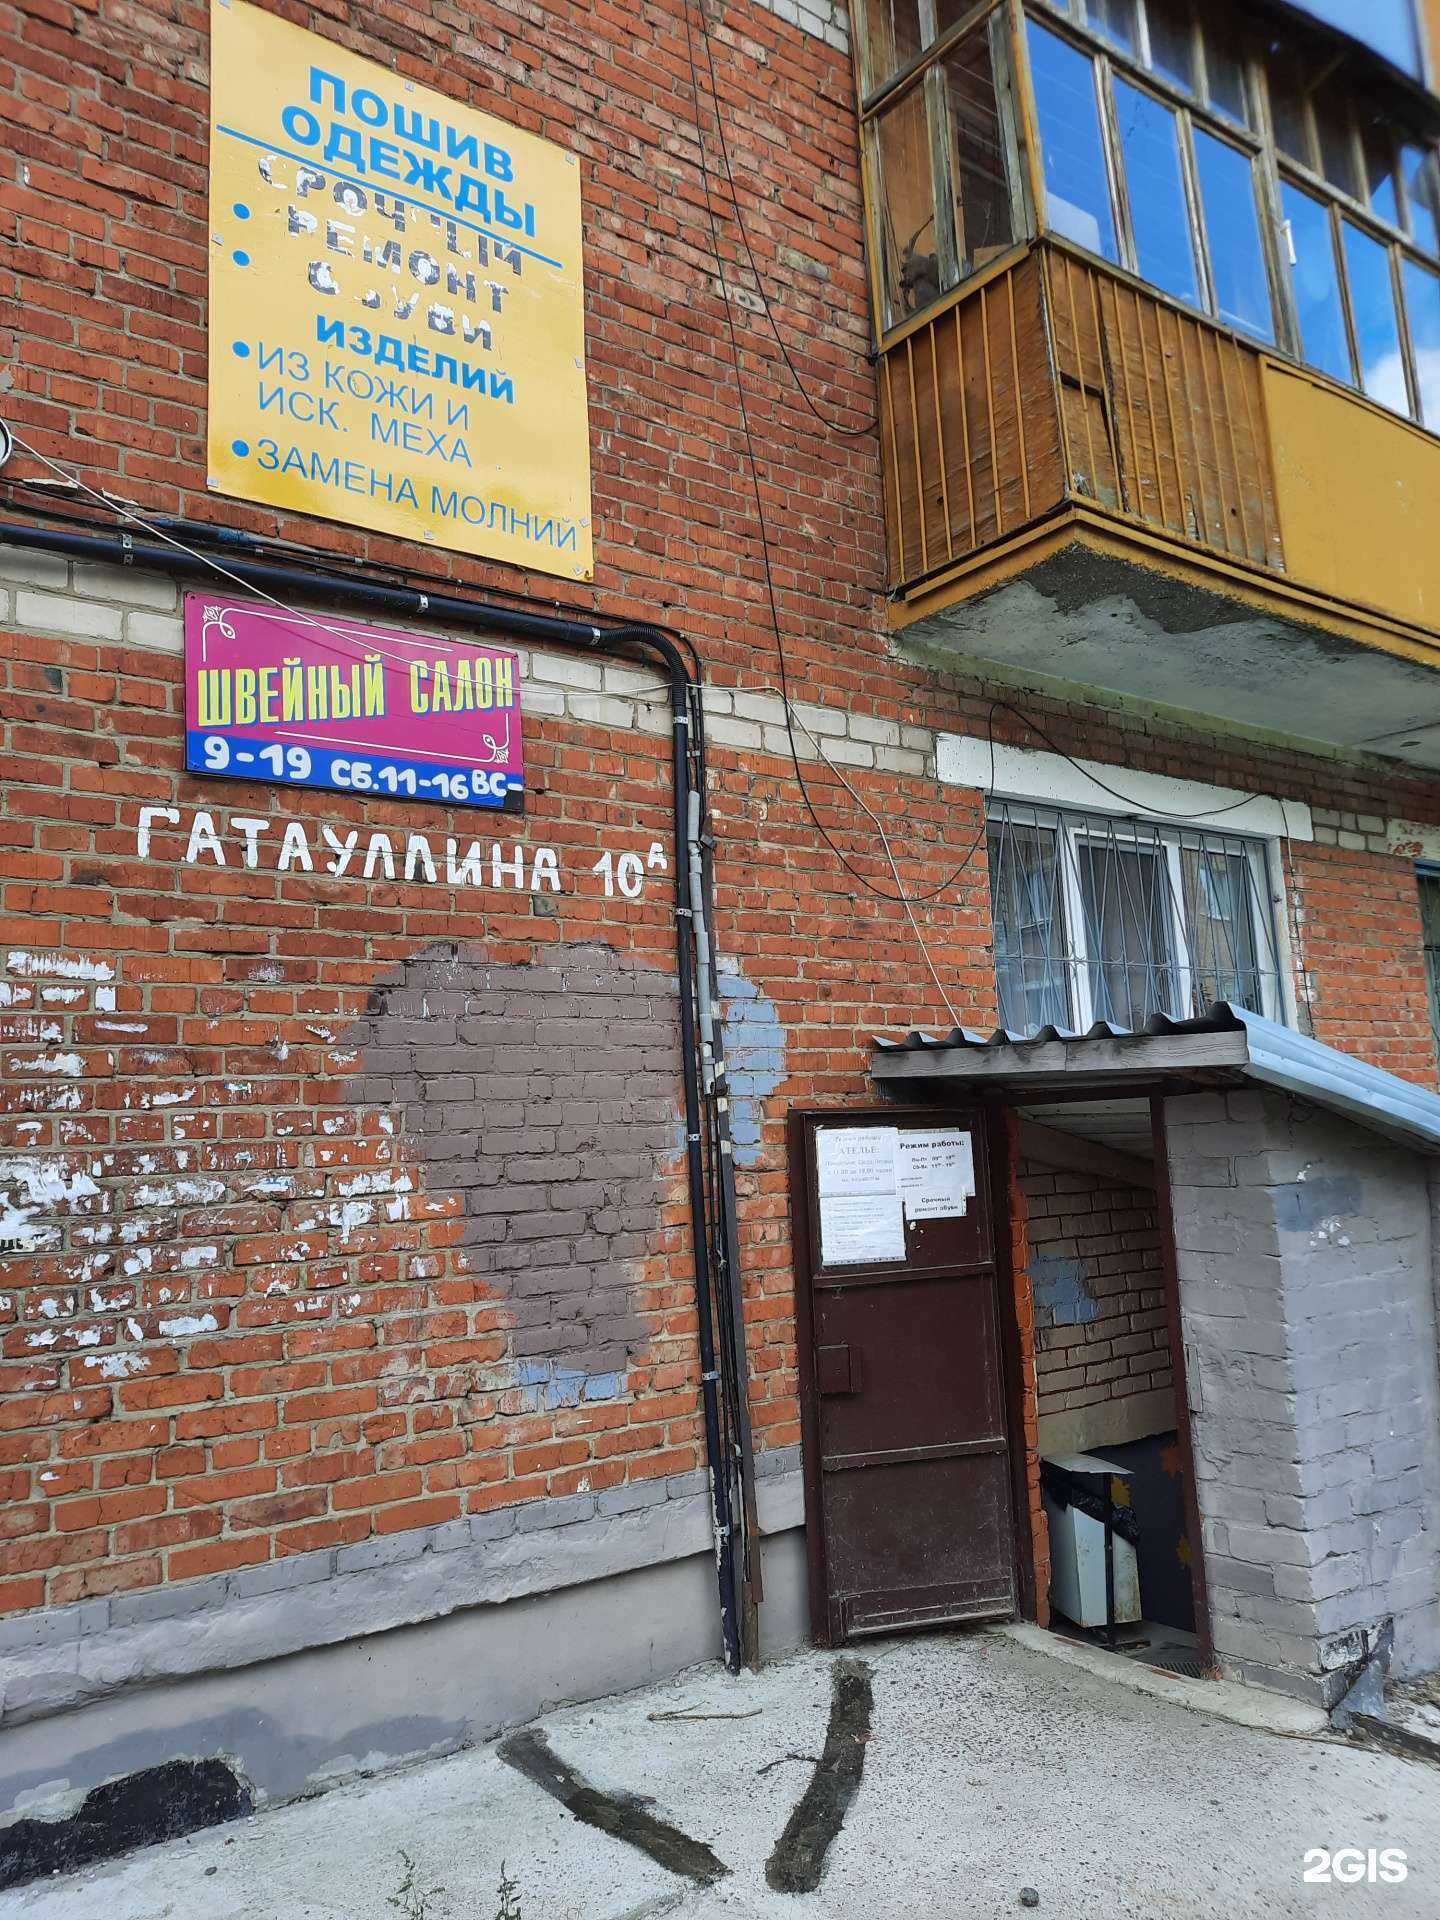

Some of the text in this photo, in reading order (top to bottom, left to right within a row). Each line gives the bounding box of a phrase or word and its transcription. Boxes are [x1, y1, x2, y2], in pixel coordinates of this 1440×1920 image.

[309, 65, 516, 184] ПОШИВ
[258, 154, 523, 277] СРОЧЫ
[280, 105, 537, 238] ОДЕЖДЫ
[287, 203, 510, 314] РЕМОНТ
[257, 341, 469, 431] ИЗ КОЖИ И
[315, 314, 515, 405] ИЗДЕЛИЙ
[258, 381, 473, 468] ИСК. МЕХА
[257, 438, 577, 551] ЗАМЕНА МОЛНИЙ
[196, 654, 514, 728] ШВЕЙНЫЙ САЛОН
[137, 806, 562, 892] ГАТАУЛЛИНА
[900, 1142, 929, 1150] Режим
